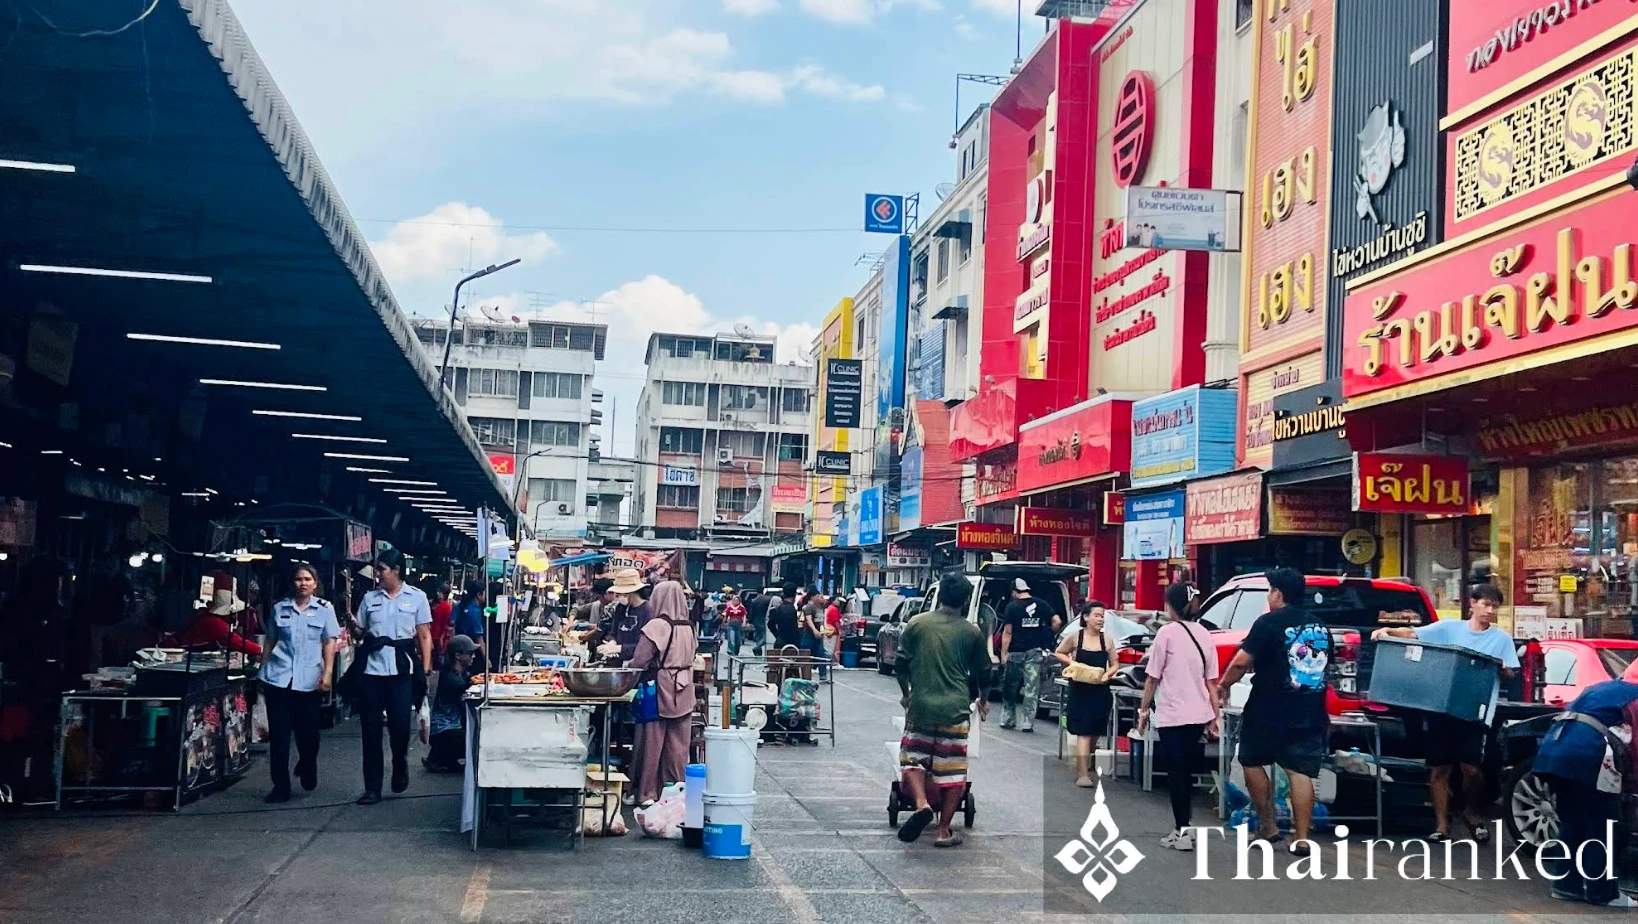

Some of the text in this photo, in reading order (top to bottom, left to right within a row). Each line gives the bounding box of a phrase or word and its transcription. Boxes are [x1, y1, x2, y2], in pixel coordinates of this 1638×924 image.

[826, 459, 849, 467] CLINIC
[1365, 461, 1464, 505] เจ๊ฝน
[1029, 515, 1090, 530] ห้างทองใจดี
[890, 544, 929, 557] ตัดผมชาย
